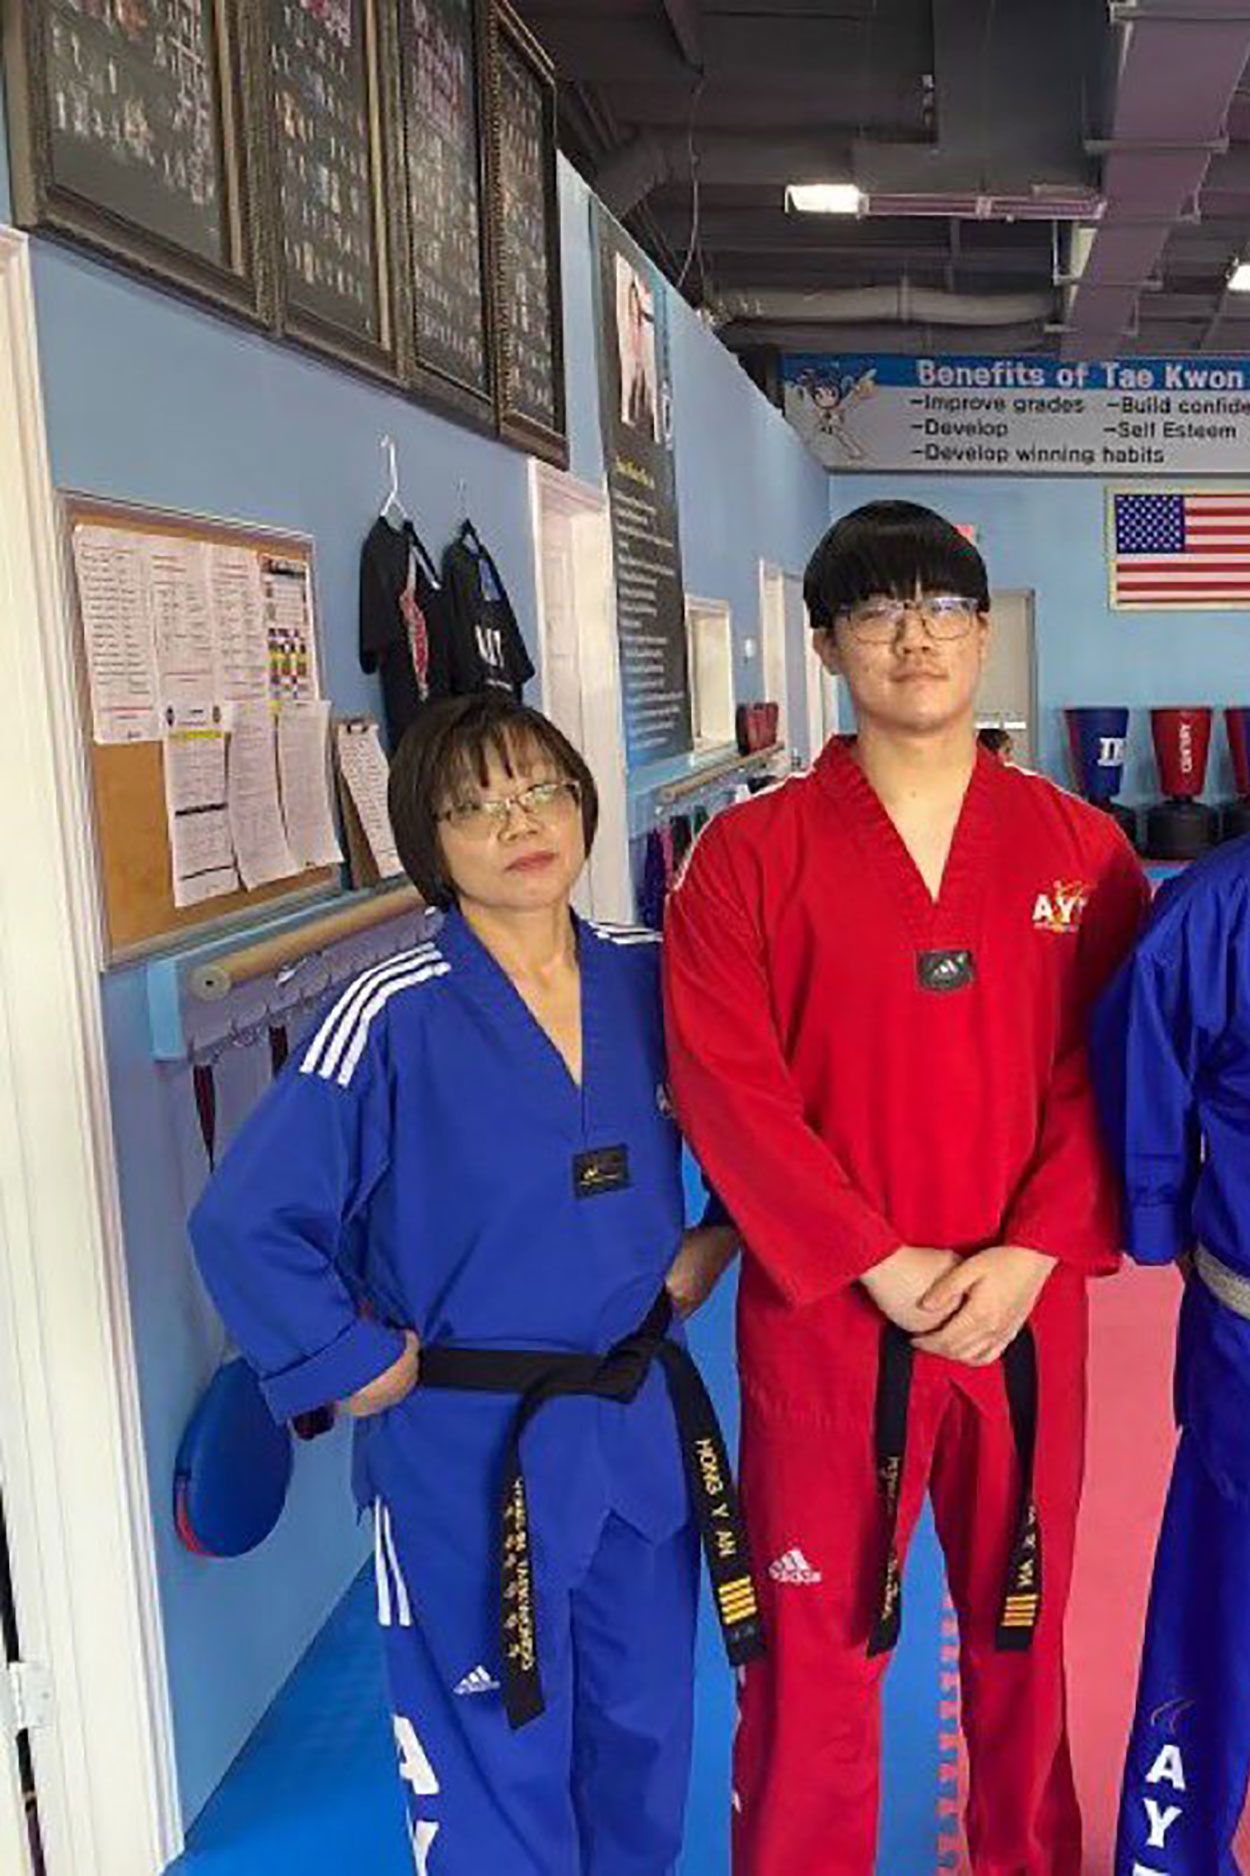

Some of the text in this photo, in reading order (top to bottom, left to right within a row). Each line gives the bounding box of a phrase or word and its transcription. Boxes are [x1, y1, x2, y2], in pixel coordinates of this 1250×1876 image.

[917, 359, 1045, 387] Benefits
[1056, 362, 1088, 387] of
[1103, 361, 1154, 389] Tae
[1165, 362, 1244, 389] Kwon
[1013, 395, 1084, 414] grades
[1163, 421, 1236, 438] Esteem
[1015, 445, 1095, 464] winning
[1103, 445, 1165, 463] habits
[695, 1437, 723, 1495] HONG
